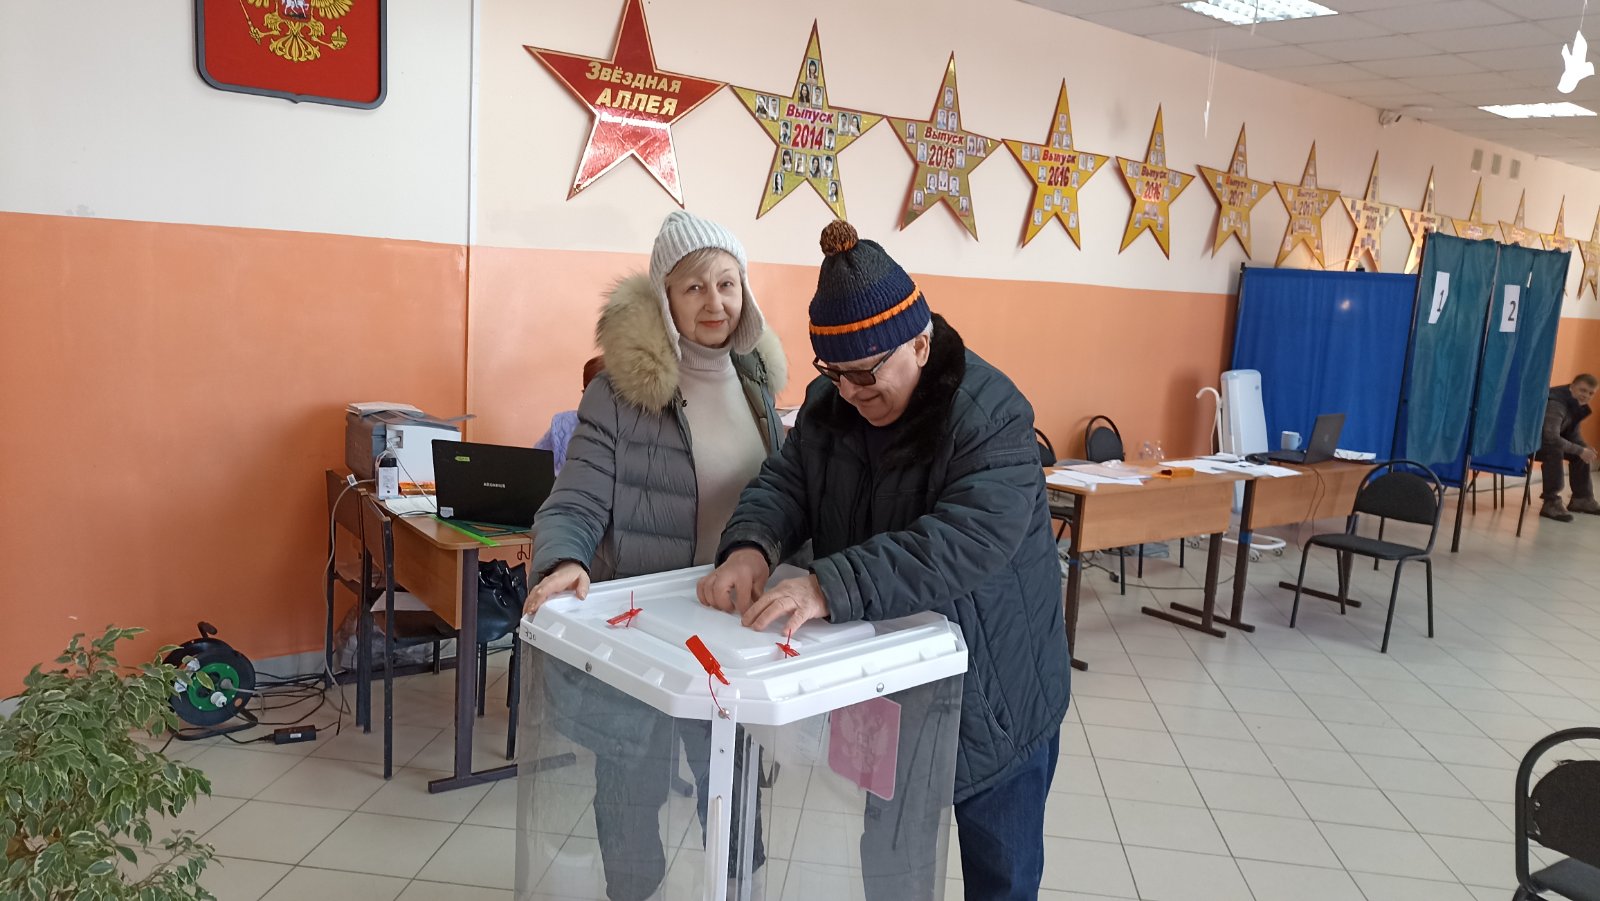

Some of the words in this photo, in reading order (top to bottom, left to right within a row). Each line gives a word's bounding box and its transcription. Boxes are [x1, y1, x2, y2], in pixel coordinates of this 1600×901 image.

[594, 87, 678, 116] АЛЛЕЯ
[786, 103, 834, 124] Выпуск
[791, 123, 824, 150] 2014
[924, 126, 965, 145] Выпуск
[928, 144, 955, 169] 2015
[1042, 149, 1077, 166] Выпуск
[1047, 166, 1070, 187] 2016
[1436, 289, 1445, 312] 1
[1507, 300, 1517, 322] 2
